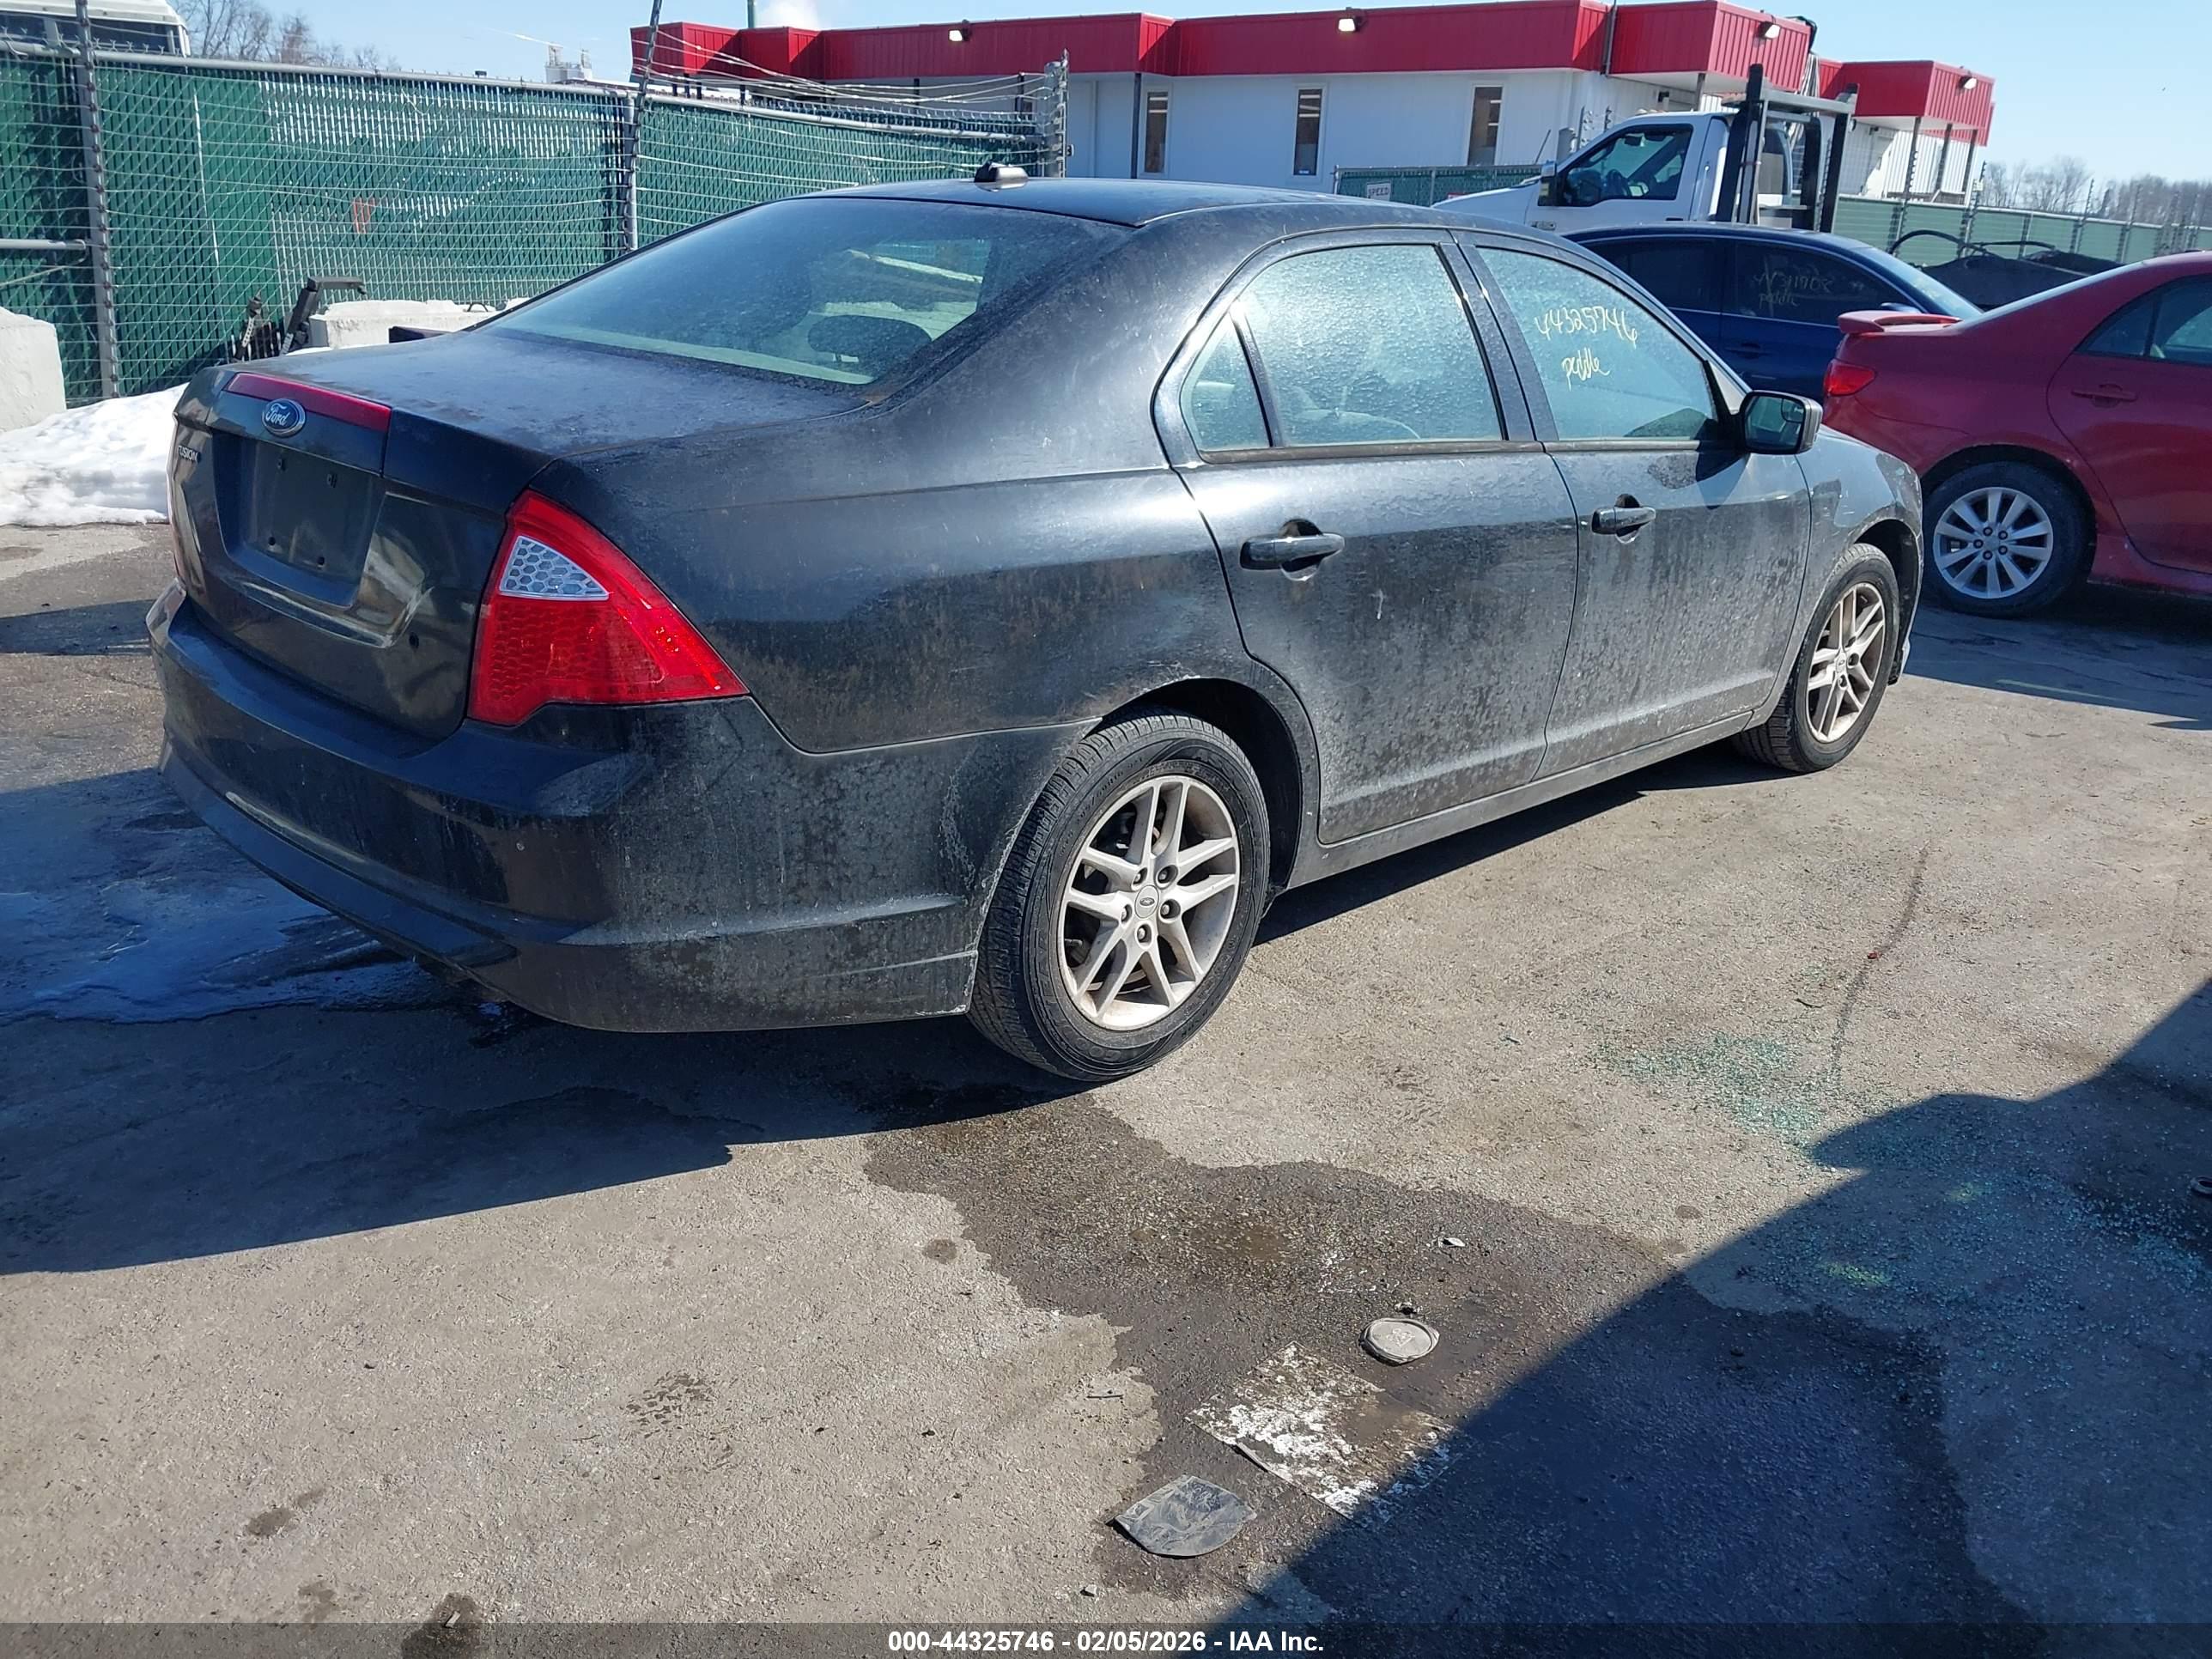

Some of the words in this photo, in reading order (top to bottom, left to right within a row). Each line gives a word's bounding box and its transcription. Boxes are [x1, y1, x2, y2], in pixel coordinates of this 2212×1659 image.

[1534, 306, 1638, 349] 44325746
[265, 403, 289, 426] Ford
[178, 445, 198, 463] FUSION
